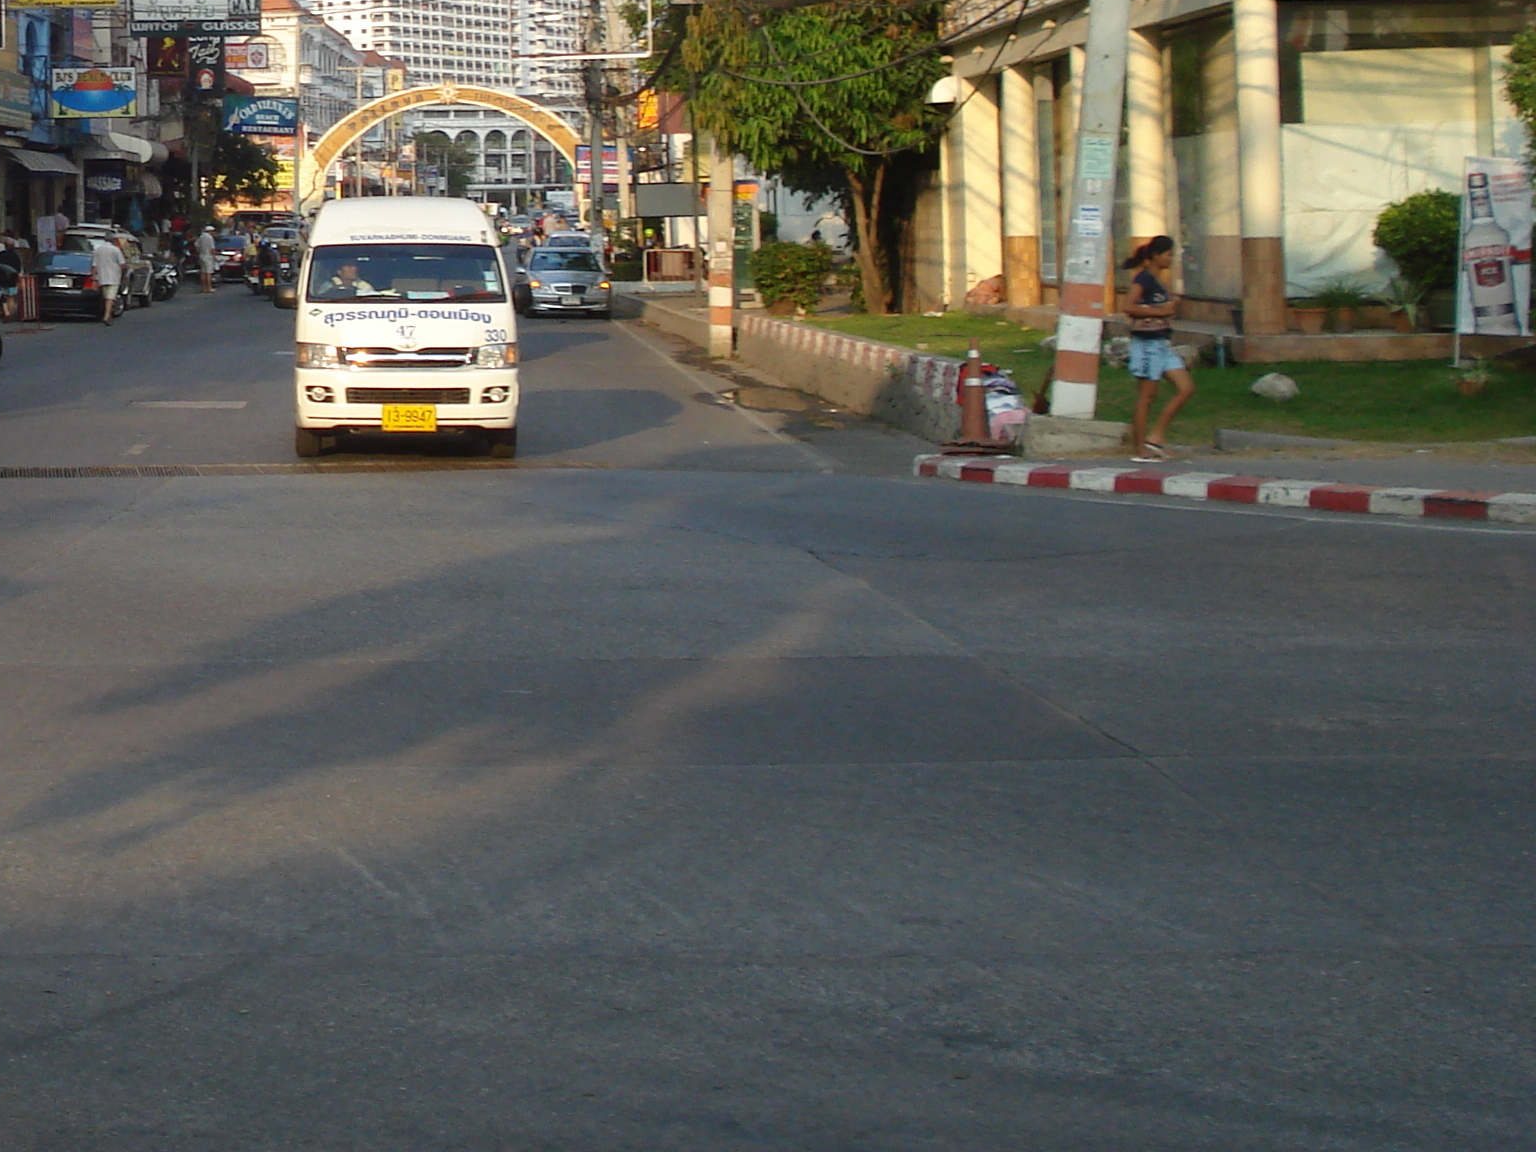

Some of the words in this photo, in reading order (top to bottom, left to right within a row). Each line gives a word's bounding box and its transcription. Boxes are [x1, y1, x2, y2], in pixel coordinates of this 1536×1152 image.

[131, 22, 178, 31] WATCH
[201, 21, 260, 31] GLASSES
[241, 125, 296, 134] RESTAURANT
[396, 326, 416, 337] 47
[485, 329, 507, 343] 330
